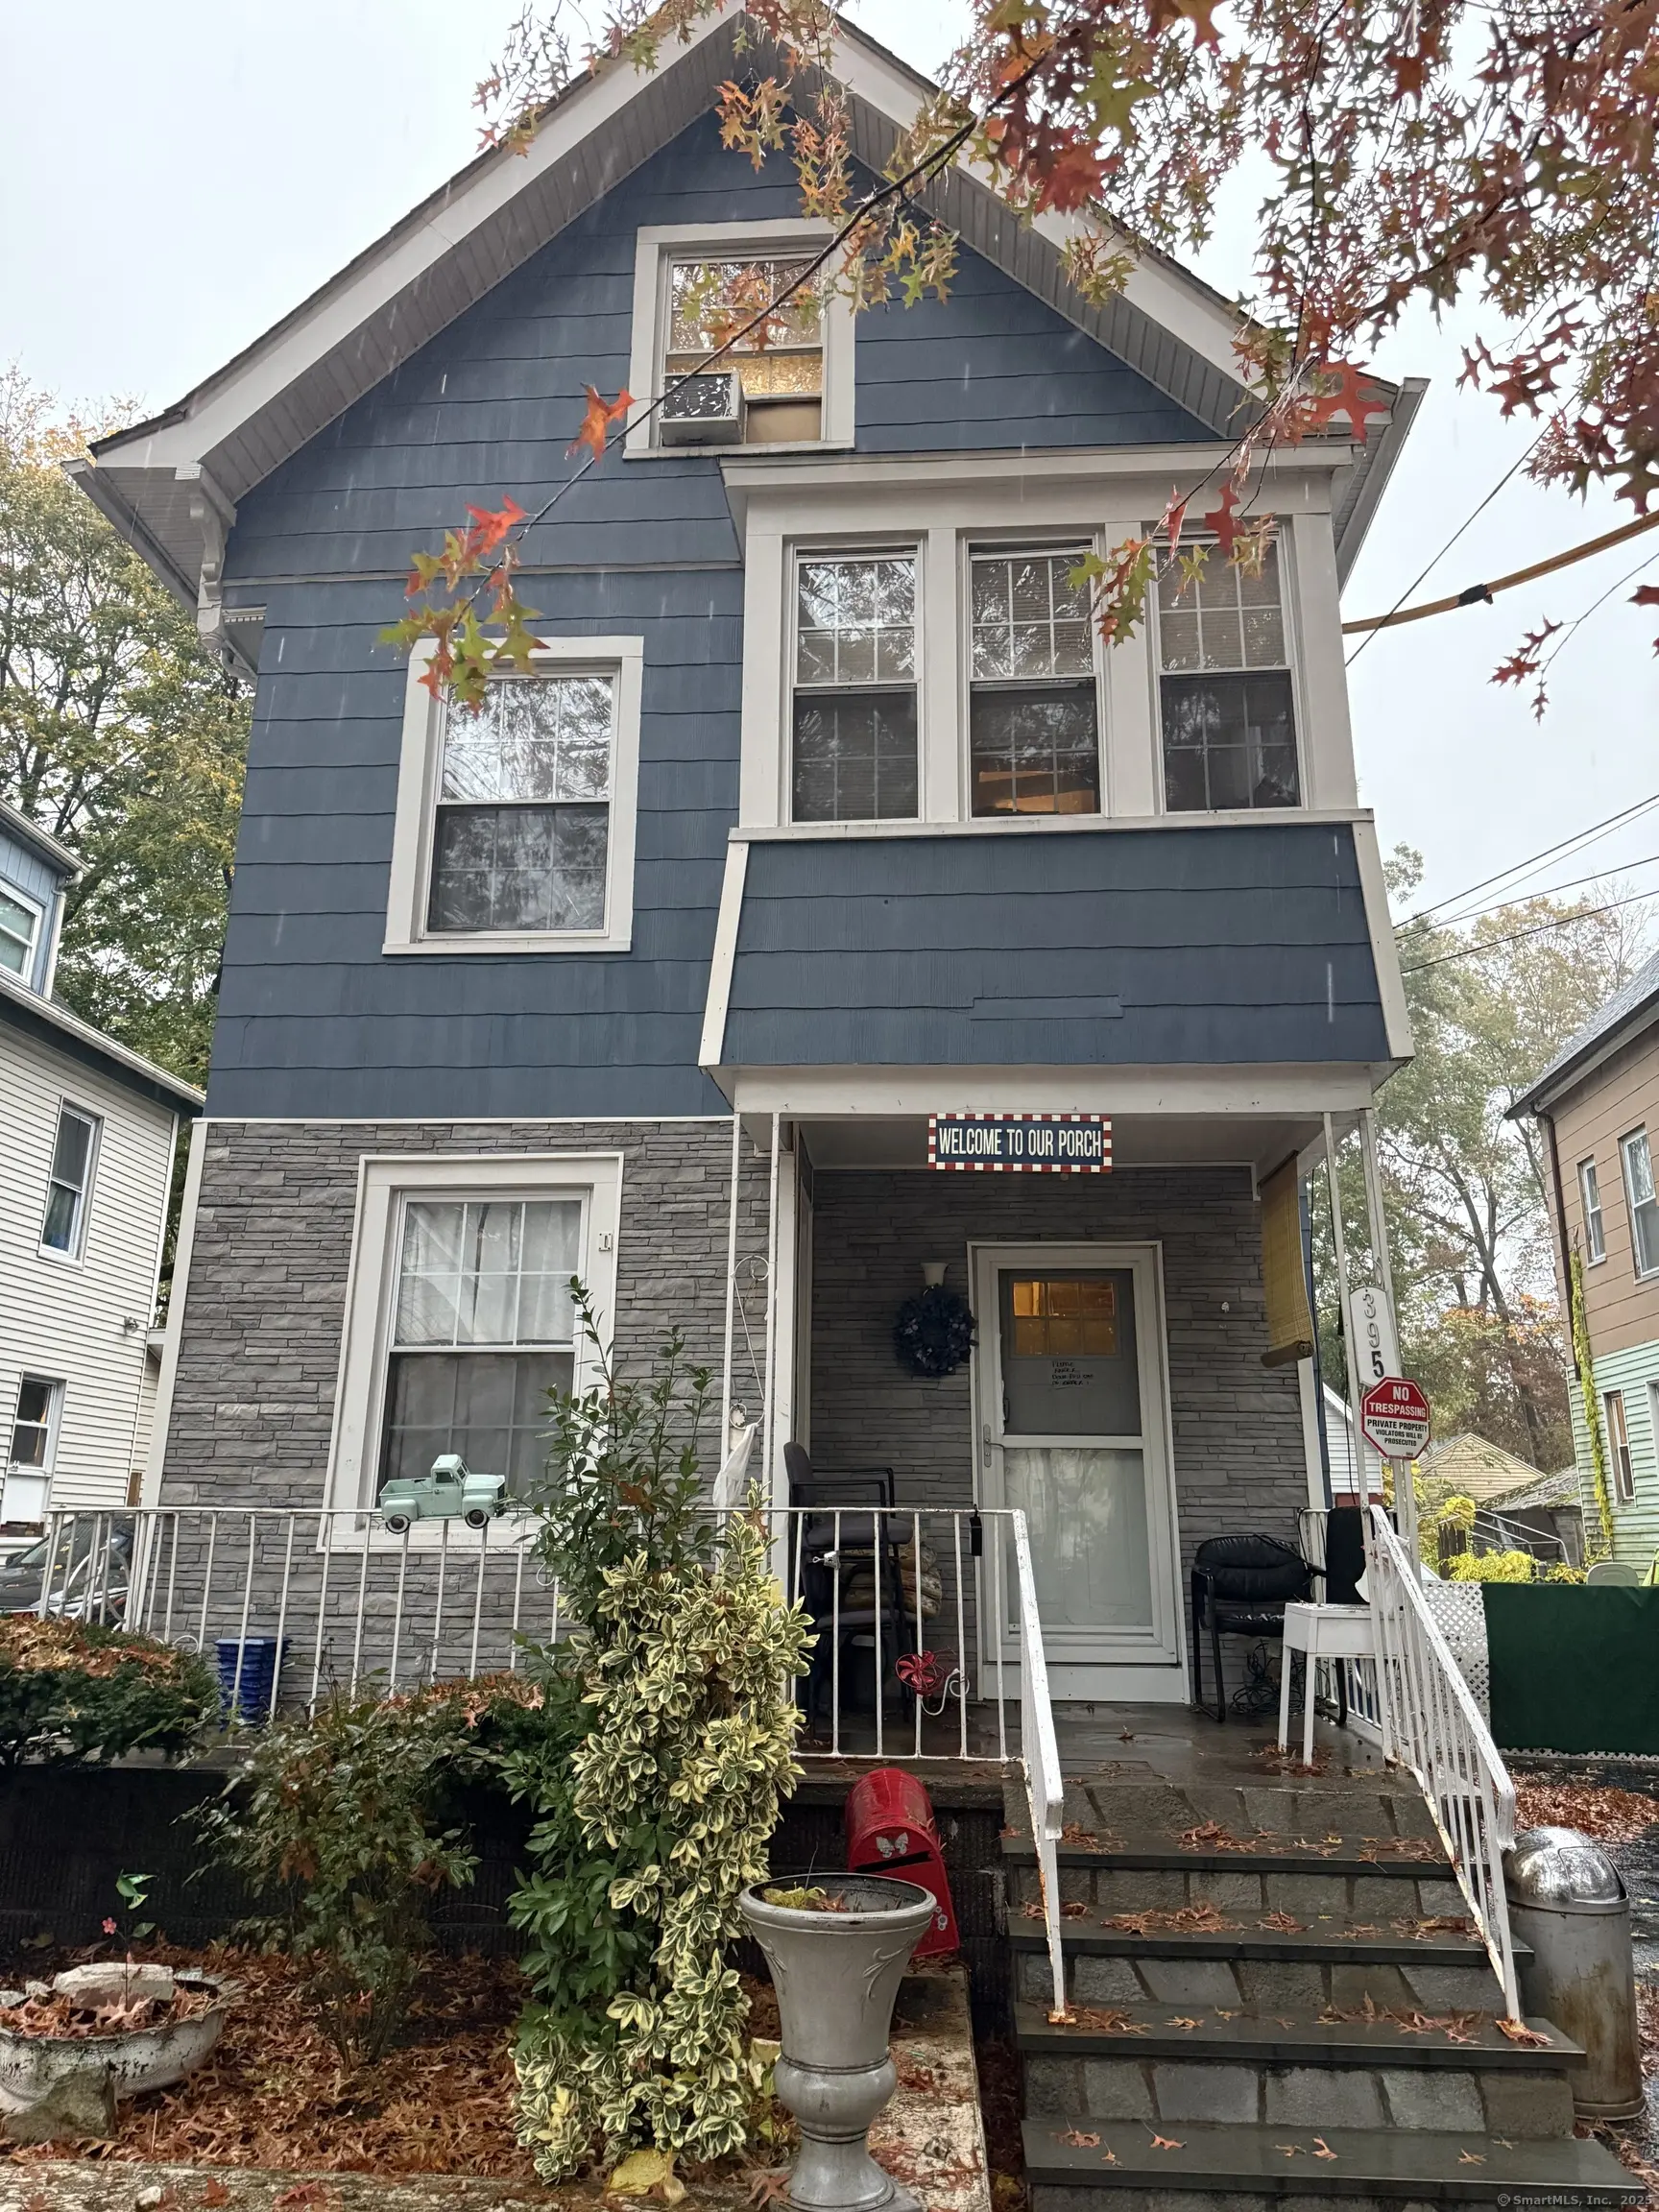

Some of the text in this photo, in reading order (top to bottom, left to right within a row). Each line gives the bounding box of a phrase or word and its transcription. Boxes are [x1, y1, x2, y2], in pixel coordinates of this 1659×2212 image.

[939, 1127, 1102, 1157] WELCOME TO OUR PORCH
[1362, 1292, 1385, 1378] 395
[1392, 1385, 1409, 1402] NO
[1369, 1402, 1427, 1418] TRESPASSING
[1367, 1419, 1428, 1432] PRIVATE PROPERTY
[1375, 1429, 1406, 1438] VIOLATORS
[1406, 1431, 1417, 1440] WILL
[1383, 1437, 1417, 1447] PROSECUTED
